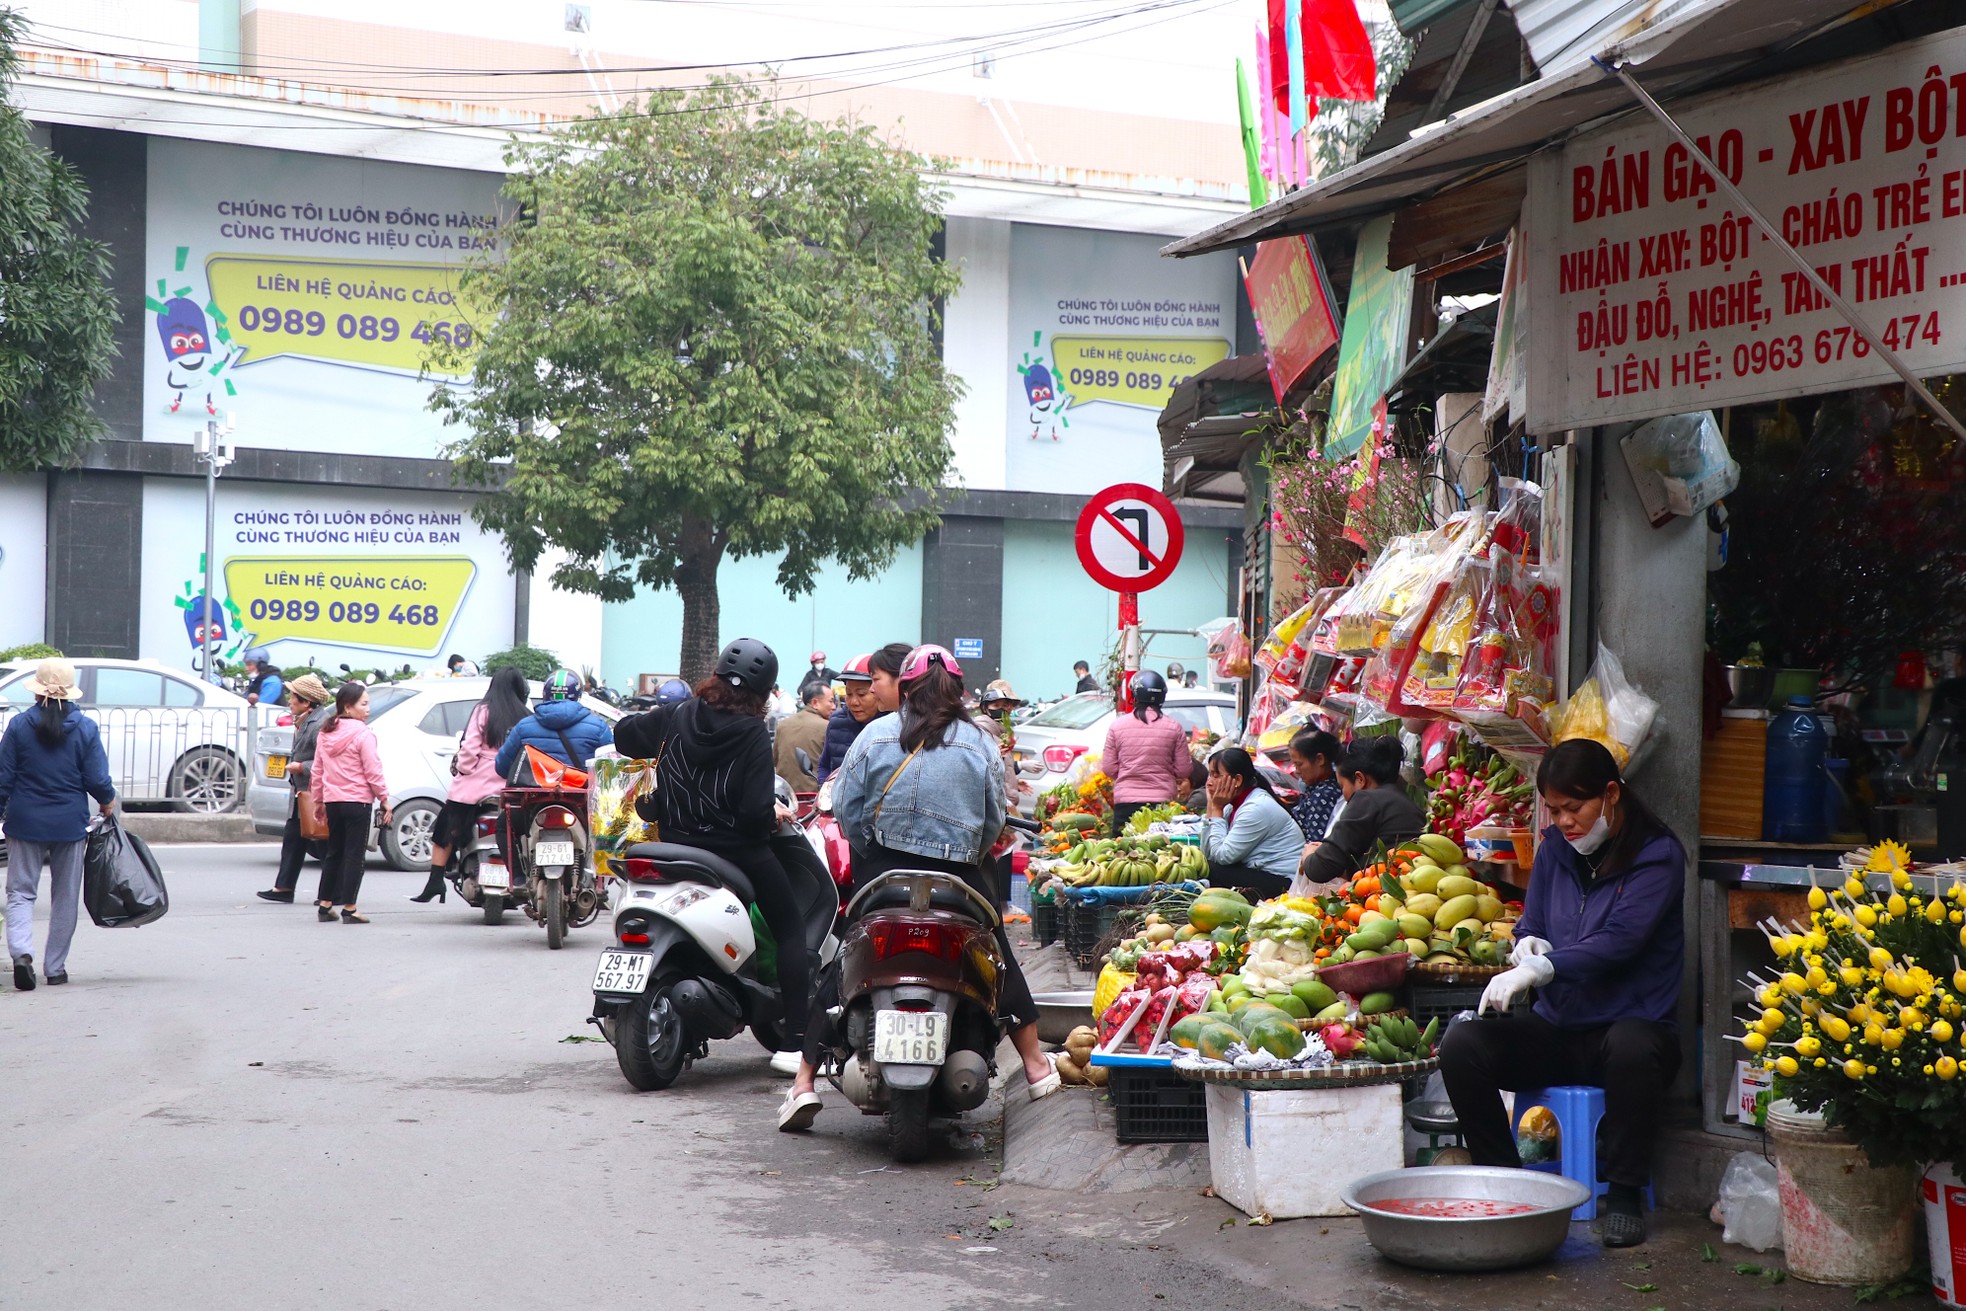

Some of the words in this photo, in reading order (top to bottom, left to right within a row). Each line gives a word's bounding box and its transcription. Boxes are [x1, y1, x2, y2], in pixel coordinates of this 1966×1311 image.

[1573, 145, 1649, 224] BÁN
[1664, 128, 1743, 209] GẠO
[1788, 96, 1870, 176] XAY
[1886, 64, 1966, 159] BỘT
[218, 199, 286, 219] CHÚNG
[292, 202, 322, 221] TÔI
[329, 206, 380, 224] LUÔN
[385, 206, 440, 227] ĐỒNG
[445, 211, 497, 229] HÀNH
[220, 220, 274, 240] CÙNG
[280, 226, 360, 244] THƯƠNG
[366, 229, 410, 250] HIỆU
[415, 230, 453, 249] CỦA
[1560, 238, 1630, 296] NHẬN
[1638, 229, 1690, 279] XAY:
[1700, 210, 1753, 272] BỘT
[1782, 187, 1863, 249] CHÁO
[1873, 163, 1930, 231] TRẺ
[1942, 169, 1966, 218] E
[257, 273, 300, 293] LIÊN
[306, 277, 332, 299] HỆ
[338, 280, 406, 302] QUẢNG
[412, 288, 457, 306] CÁO:
[1577, 300, 1628, 357] ĐẬU
[1636, 280, 1679, 341] ĐỖ,
[1689, 270, 1771, 332] NGHỆ,
[1781, 264, 1841, 315] TAM
[1852, 233, 1929, 303] THẤT
[1057, 298, 1097, 311] CHÚNG
[1100, 300, 1118, 311] TÔI
[1122, 300, 1151, 312] LUÔN
[1154, 300, 1186, 313] ĐỒNG
[1189, 300, 1220, 313] HÀNH
[239, 305, 326, 337] 0989
[336, 313, 400, 342] 089
[410, 320, 473, 348] 468
[1059, 313, 1090, 325] CÙNG
[1094, 315, 1140, 326] THƯƠNG
[1143, 315, 1168, 328] HIỆU
[1171, 314, 1194, 327] CỦA
[1196, 317, 1219, 329] BẠN
[1080, 346, 1104, 359] LIÊN
[1108, 348, 1123, 363] HỆ
[1126, 349, 1166, 362] QUẢNG
[1169, 352, 1196, 364] CÁO:
[1597, 353, 1660, 398] LIÊN
[1672, 340, 1721, 390] HỆ:
[1733, 335, 1804, 377] 0963
[1814, 326, 1870, 364] 678
[1882, 311, 1940, 352] 474
[1070, 368, 1119, 387] 0989
[1126, 372, 1162, 390] 089
[234, 510, 290, 525] CHÚNG
[294, 510, 319, 525] TÔI
[324, 510, 365, 525] LUÔN
[370, 509, 414, 525] ĐỒNG
[418, 510, 461, 525] HÀNH
[236, 528, 280, 543] CÙNG
[284, 530, 350, 543] THƯƠNG
[354, 529, 389, 546] HIỆU
[394, 528, 424, 543] CỦA
[429, 532, 460, 546] BẠN
[265, 571, 300, 586] LIÊN
[305, 572, 325, 590] HỆ
[330, 572, 386, 590] QUẢNG
[390, 576, 427, 591] CÁO:
[250, 599, 320, 621] 0989
[329, 601, 380, 624] 089
[388, 604, 438, 626] 468
[596, 972, 644, 990] 567.97
[885, 1038, 937, 1060] 4166
